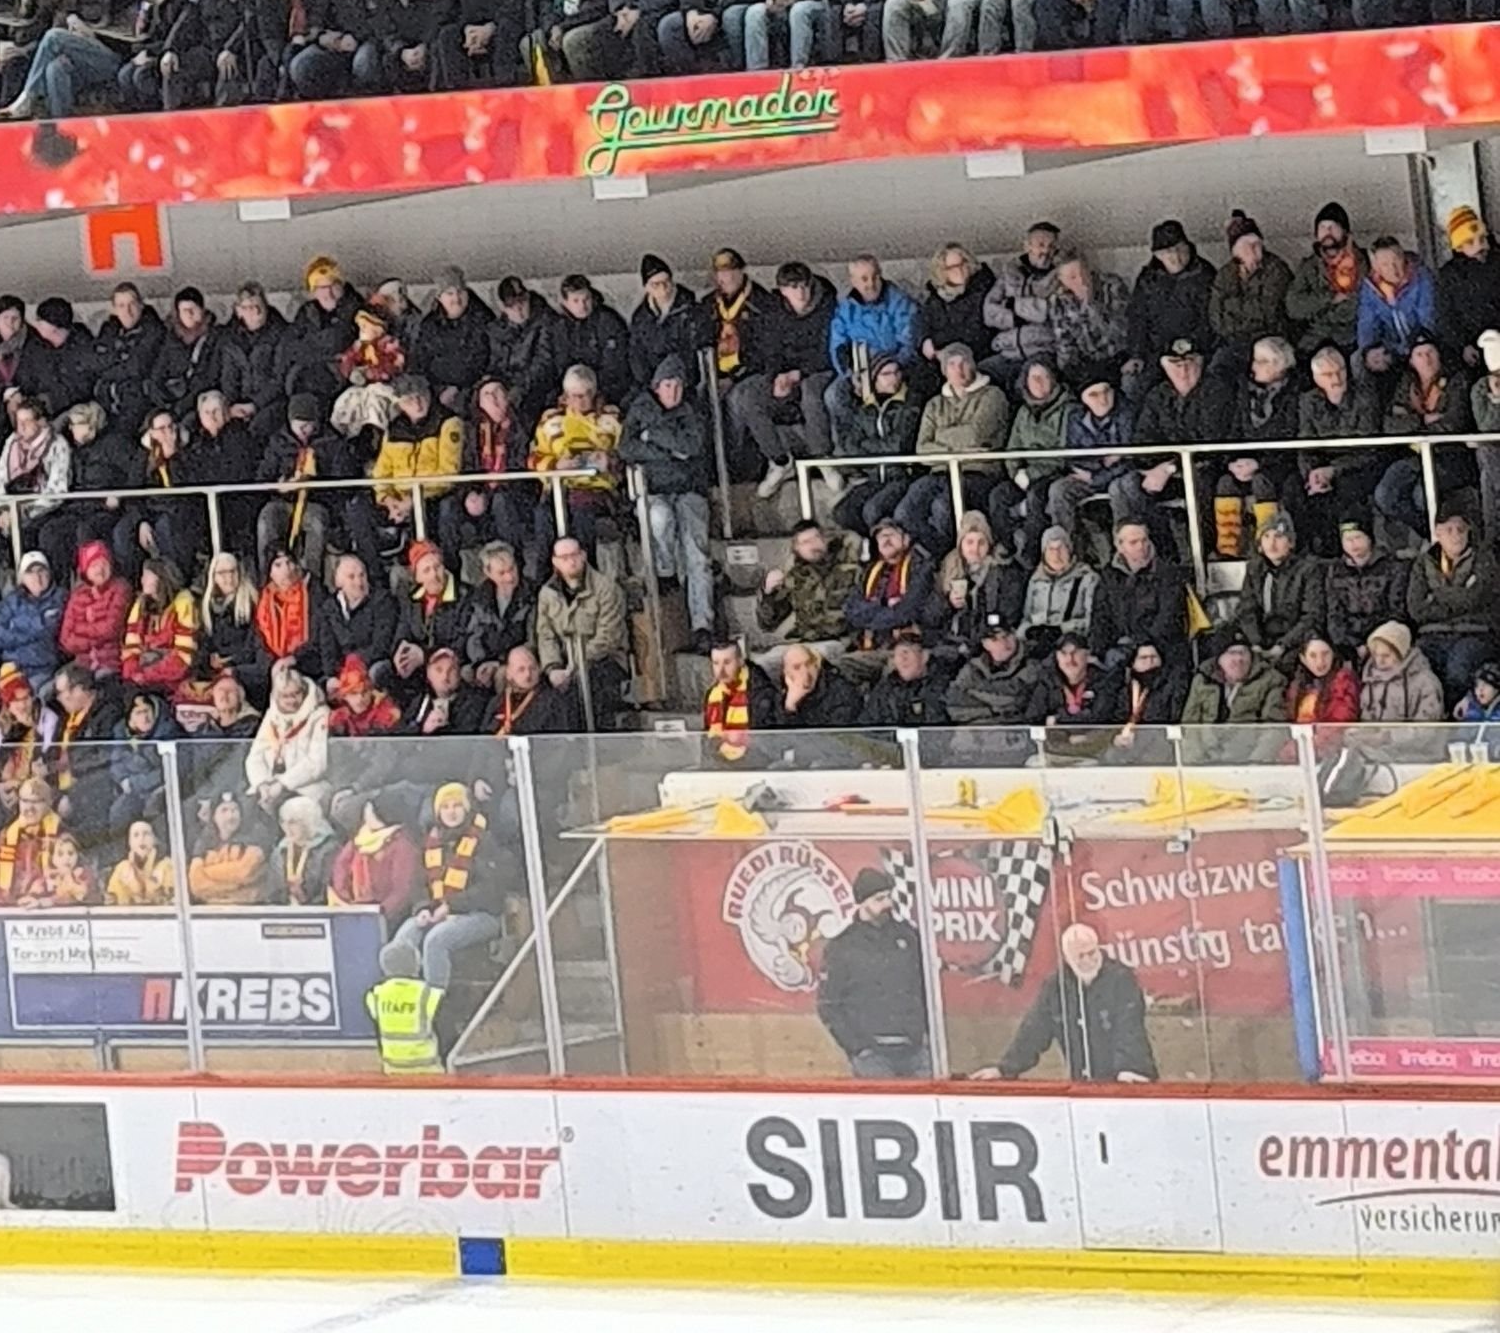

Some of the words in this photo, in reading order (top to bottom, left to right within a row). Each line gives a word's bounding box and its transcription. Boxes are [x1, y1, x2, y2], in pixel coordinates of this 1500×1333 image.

[583, 71, 842, 176] Gourmador
[727, 847, 776, 920] RUEDI
[929, 876, 995, 908] MINI
[172, 977, 332, 1023] KREBS
[174, 1120, 561, 1200] Powerbar
[745, 1115, 1048, 1223] SIBIR
